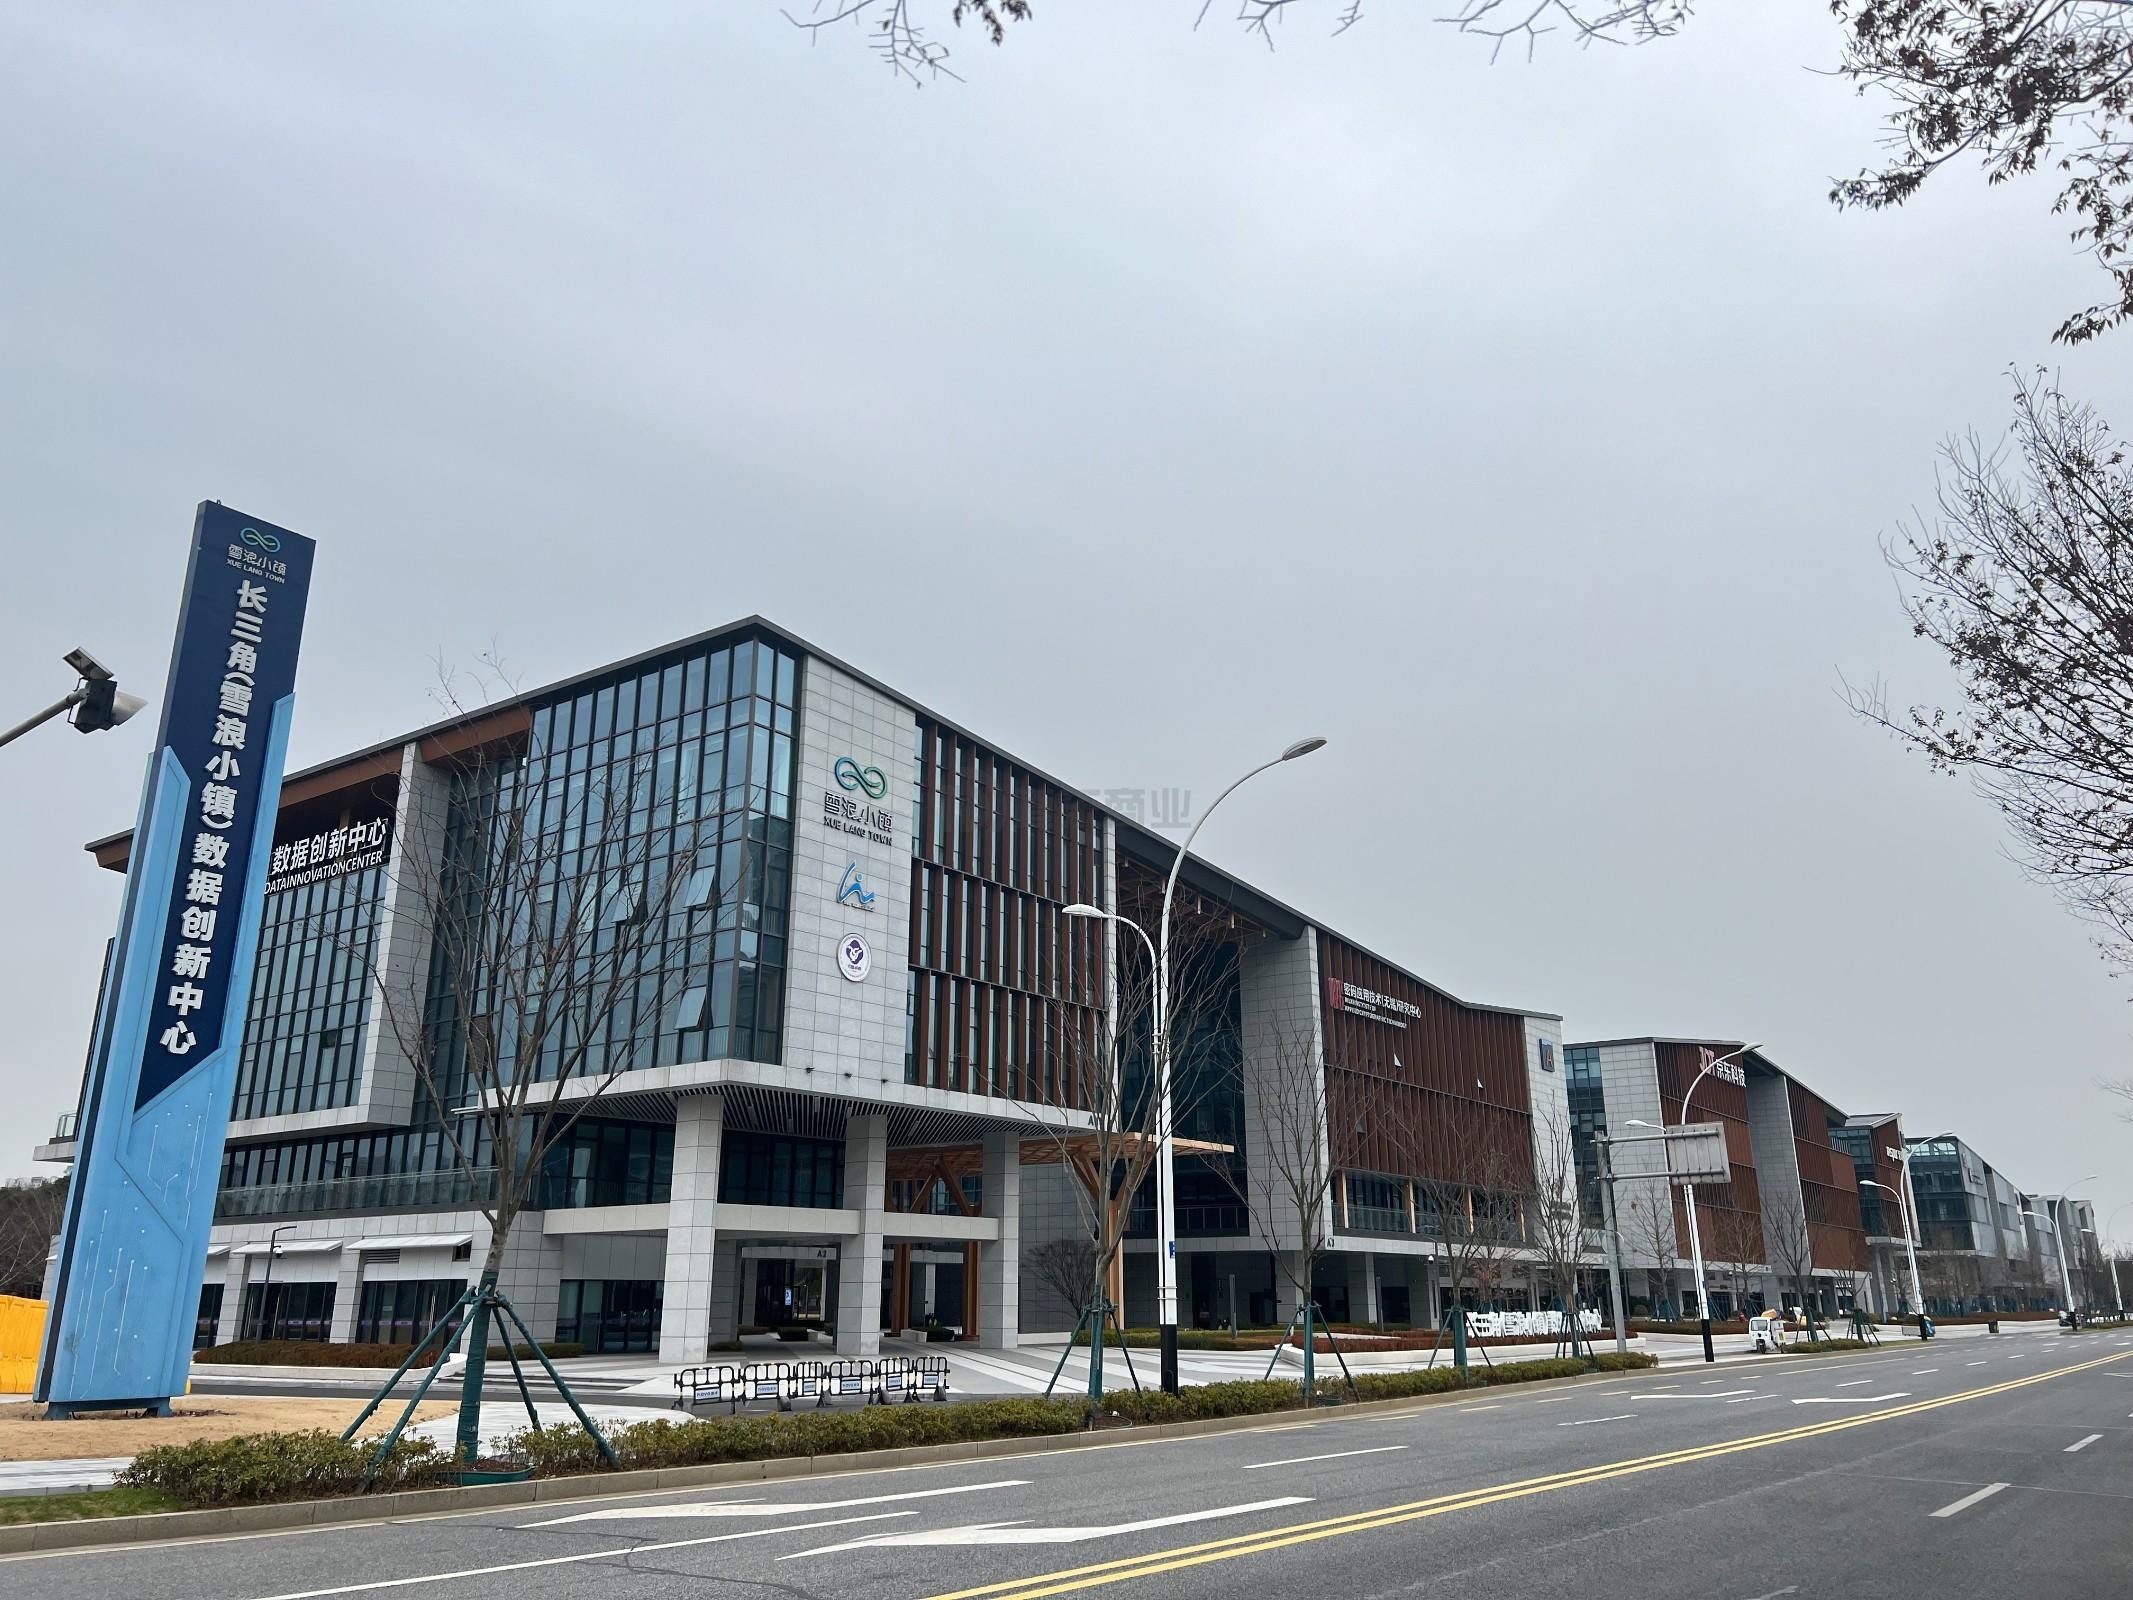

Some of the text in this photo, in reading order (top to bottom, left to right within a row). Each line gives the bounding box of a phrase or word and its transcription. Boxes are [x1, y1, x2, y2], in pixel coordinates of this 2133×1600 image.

[227, 559, 285, 584] XUE LANG TOWN
[228, 544, 286, 576] 雪浪小镇
[824, 791, 893, 833] 雪浪小镇
[271, 816, 387, 876] 数据创新中心
[823, 815, 893, 847] XUE LANG TOWN
[1715, 1058, 1747, 1088] 京东科技
